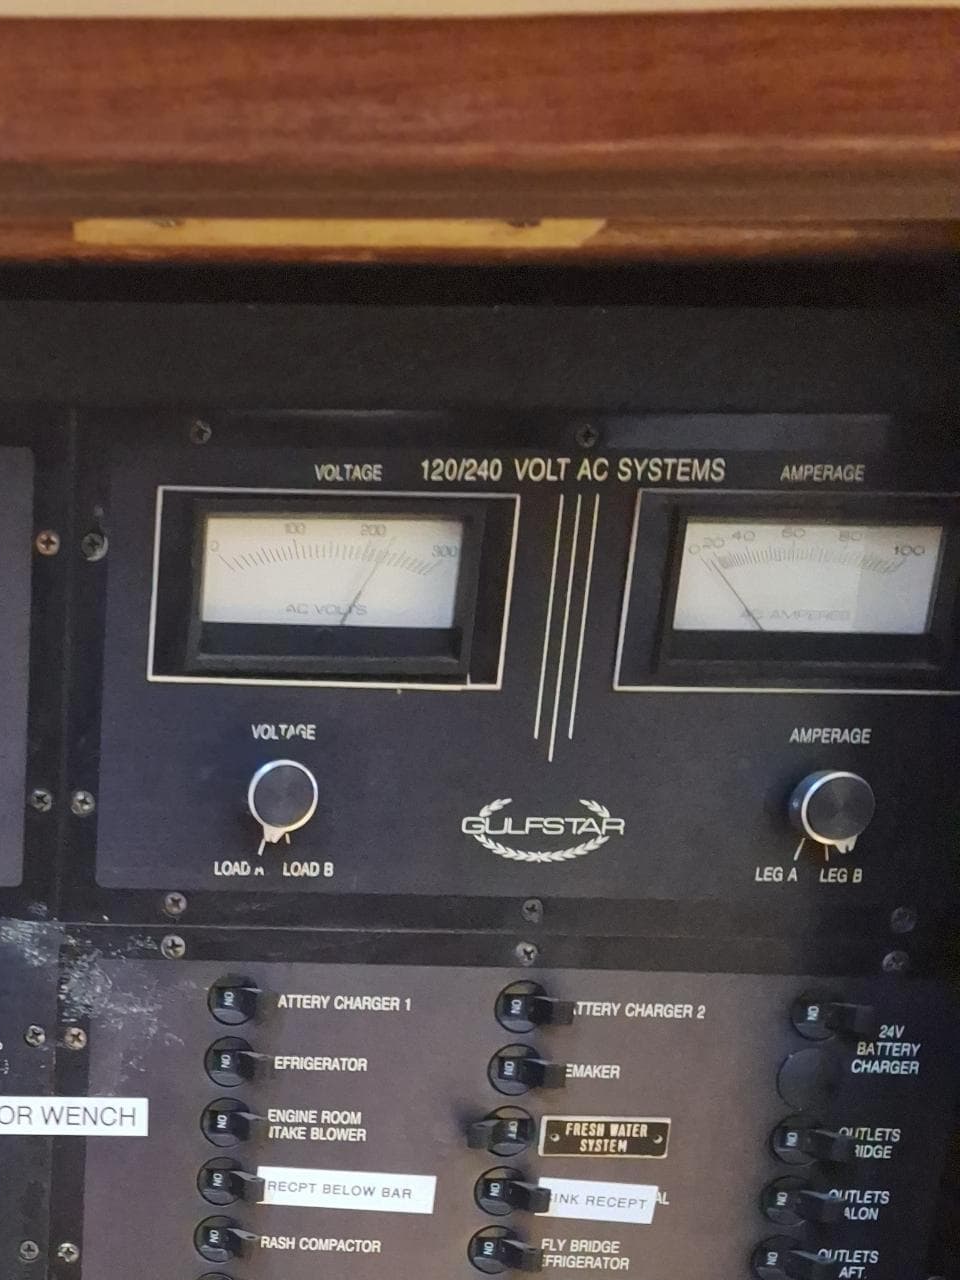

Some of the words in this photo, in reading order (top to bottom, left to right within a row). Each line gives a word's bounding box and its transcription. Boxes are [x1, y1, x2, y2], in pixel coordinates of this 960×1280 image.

[315, 464, 382, 481] VOLTAGE
[421, 459, 502, 481] 120/240
[515, 459, 570, 481] VOLT
[577, 459, 609, 481] AC
[618, 459, 726, 481] SYSTEMS
[781, 465, 865, 483] AMPERAGE
[893, 543, 926, 556] 100
[252, 724, 316, 740] VOLTAGE
[790, 729, 871, 744] AMPERAGE
[461, 817, 625, 836] GULFSTAR
[214, 861, 251, 876] LOAD
[283, 861, 320, 877] LOAD
[323, 861, 333, 877] B
[755, 867, 784, 882] LEG
[787, 868, 798, 882] A
[820, 868, 849, 883] LEG
[853, 868, 862, 883] B
[277, 995, 330, 1010] ATTERY
[334, 996, 400, 1011] CHARGER
[405, 998, 411, 1010] 1
[625, 1003, 692, 1018] CHARGER
[697, 1005, 706, 1019] 2
[879, 1025, 904, 1039] 24V
[857, 1042, 921, 1057] BATTERY
[275, 1056, 368, 1072] EFRIGERATOR
[851, 1060, 919, 1075] CHARGER
[39, 1107, 136, 1127] WENCH
[268, 1109, 318, 1124] ENGINE
[321, 1111, 362, 1125] ROOM
[310, 1127, 367, 1141] BLOWER
[566, 1122, 605, 1137] FRESH
[611, 1123, 648, 1138] WATER
[839, 1127, 901, 1141] OUTLETS
[580, 1139, 628, 1153] SYSTEM
[268, 1181, 315, 1193] RECPT
[323, 1183, 376, 1197] BELOW
[382, 1186, 412, 1199] BAR
[828, 1190, 890, 1204] OUTLETS
[586, 1195, 647, 1209] RECEPT
[261, 1236, 296, 1250] RASH
[300, 1237, 381, 1253] COMPACTOR
[542, 1239, 565, 1252] FLY
[570, 1239, 620, 1254] BRIDGE
[817, 1249, 879, 1263] OUTLETS
[839, 1266, 867, 1279] AFT.
